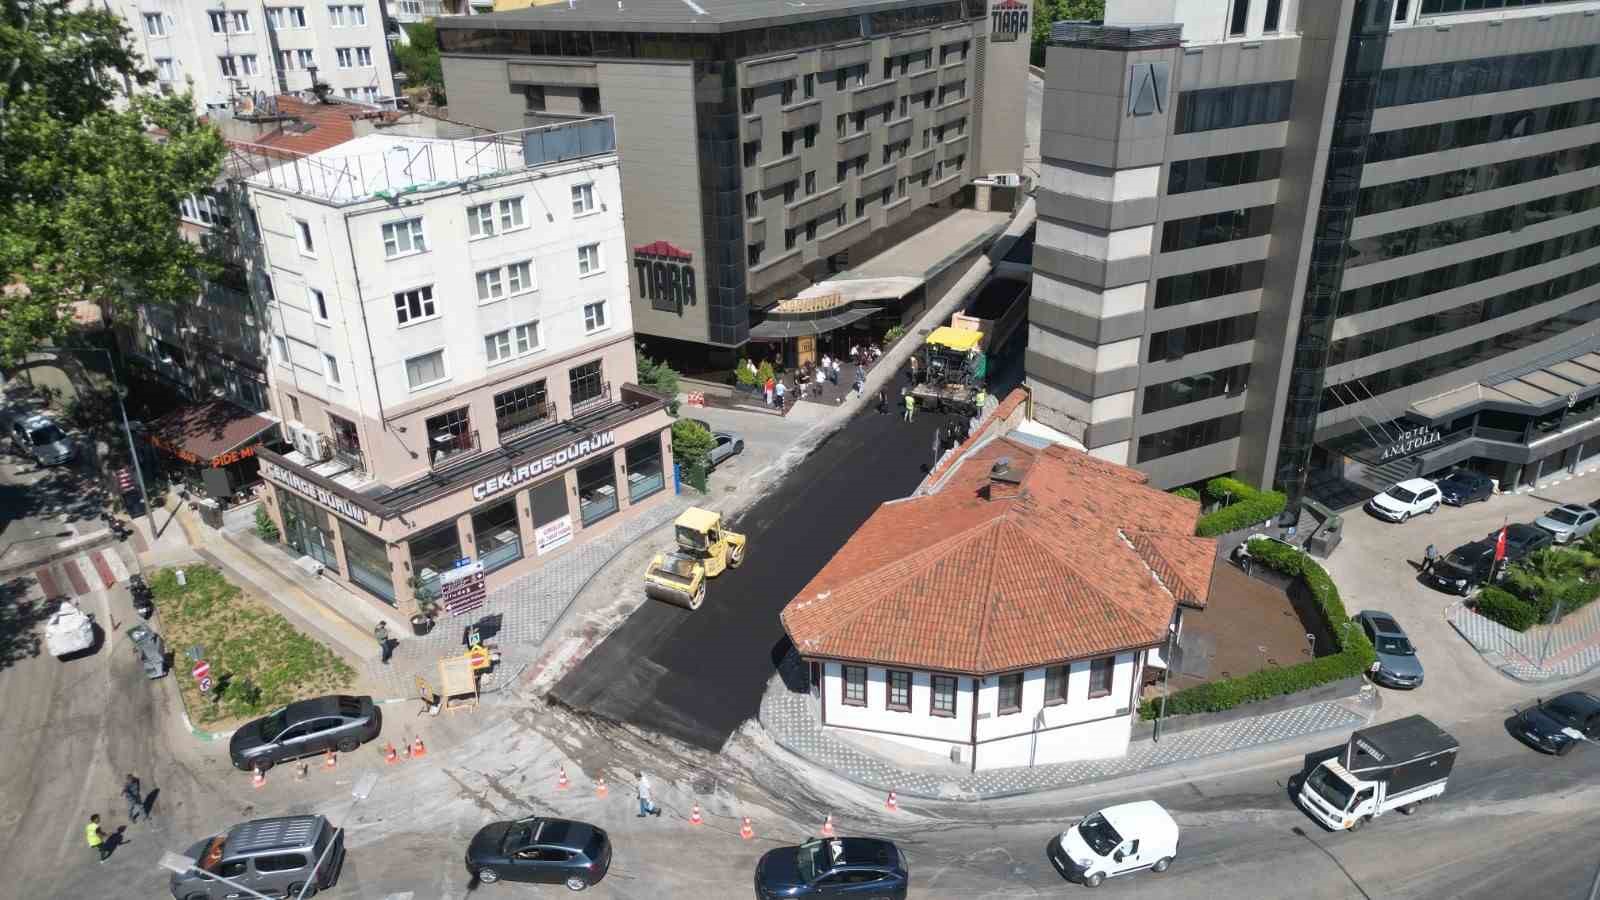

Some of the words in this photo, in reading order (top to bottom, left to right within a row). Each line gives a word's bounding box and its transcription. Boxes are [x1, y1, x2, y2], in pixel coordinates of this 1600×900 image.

[991, 10, 1028, 33] TIARA
[634, 258, 697, 307] TIARA
[1380, 431, 1440, 460] ANATOLIA
[1398, 424, 1430, 441] HOTEL
